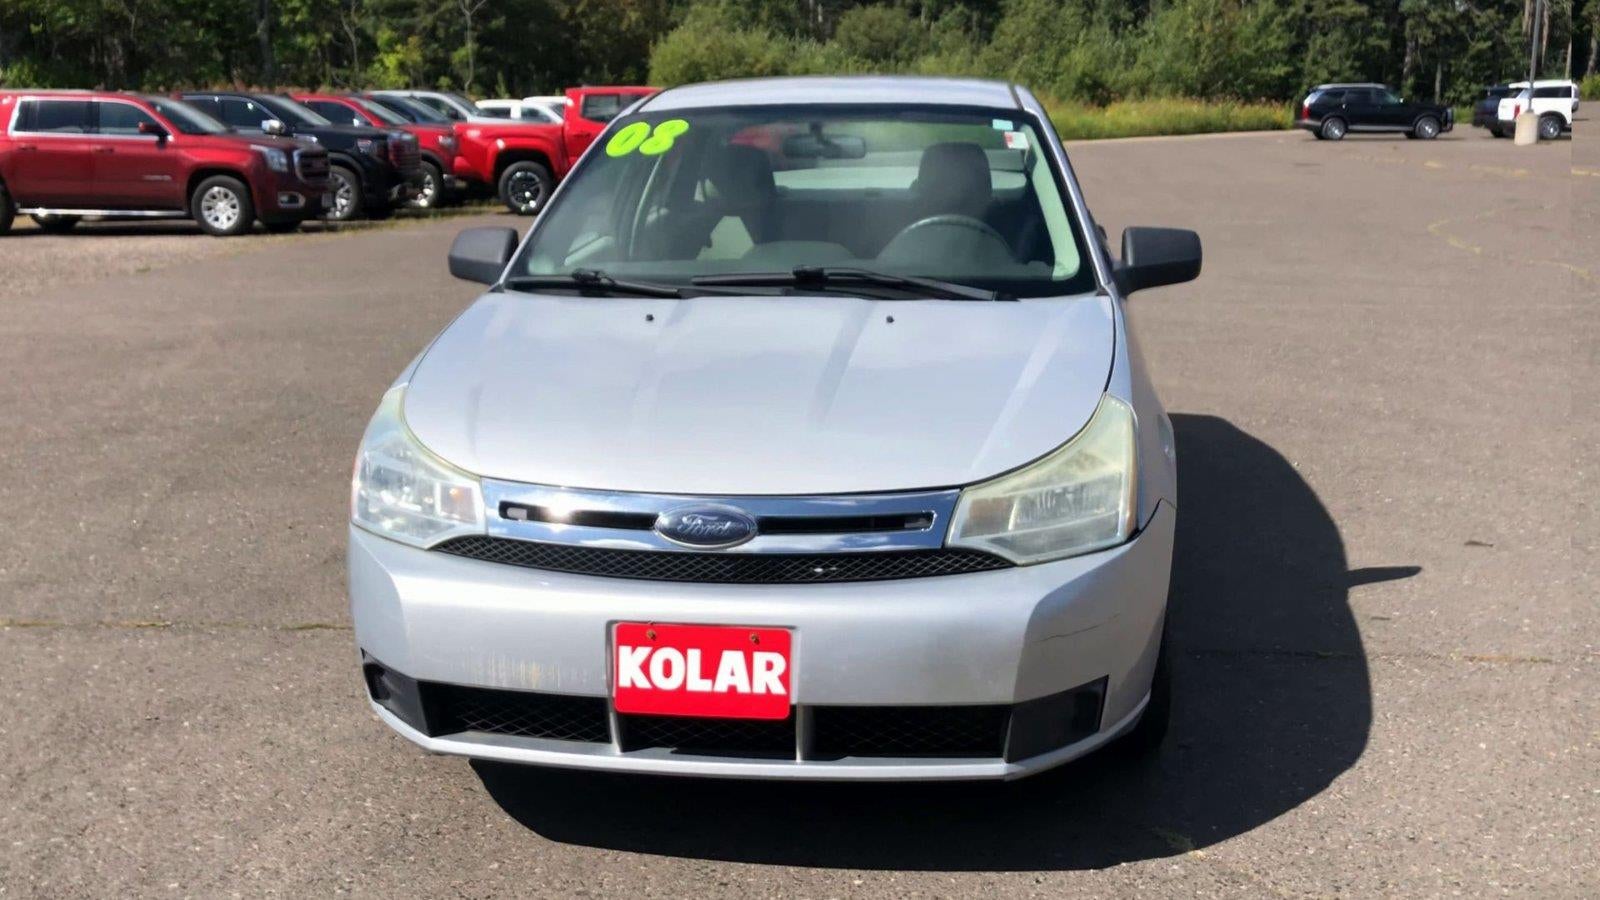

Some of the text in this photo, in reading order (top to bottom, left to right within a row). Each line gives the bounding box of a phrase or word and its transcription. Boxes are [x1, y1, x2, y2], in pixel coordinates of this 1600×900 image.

[606, 119, 690, 157] 08
[676, 513, 733, 536] Ford
[618, 645, 787, 695] KOLAR
